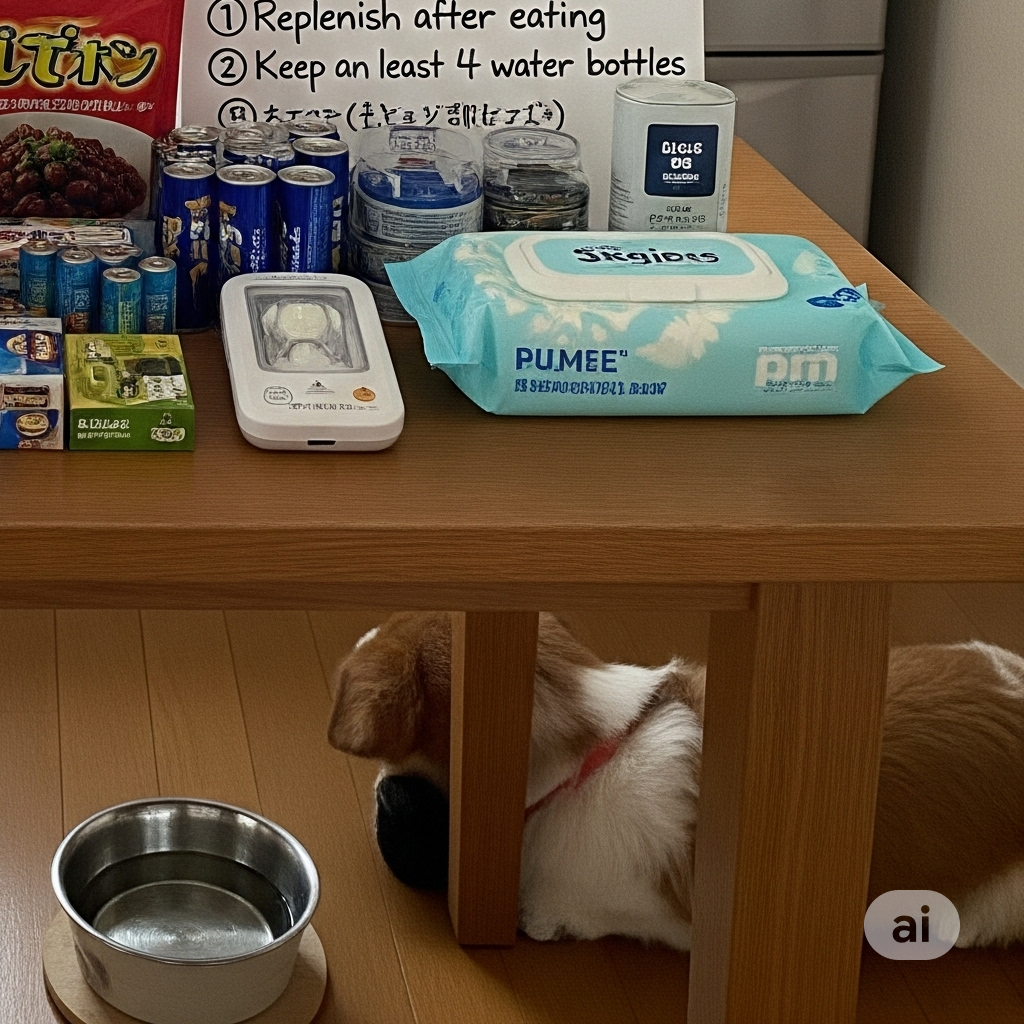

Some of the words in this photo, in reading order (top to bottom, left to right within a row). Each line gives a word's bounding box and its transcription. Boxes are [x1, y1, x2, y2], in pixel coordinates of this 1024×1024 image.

[509, 0, 606, 42] eating
[255, 49, 326, 93] Keep
[335, 59, 369, 80] an
[379, 48, 445, 80] least
[456, 47, 482, 80] 4
[490, 48, 575, 78] water
[587, 46, 686, 77] bottles
